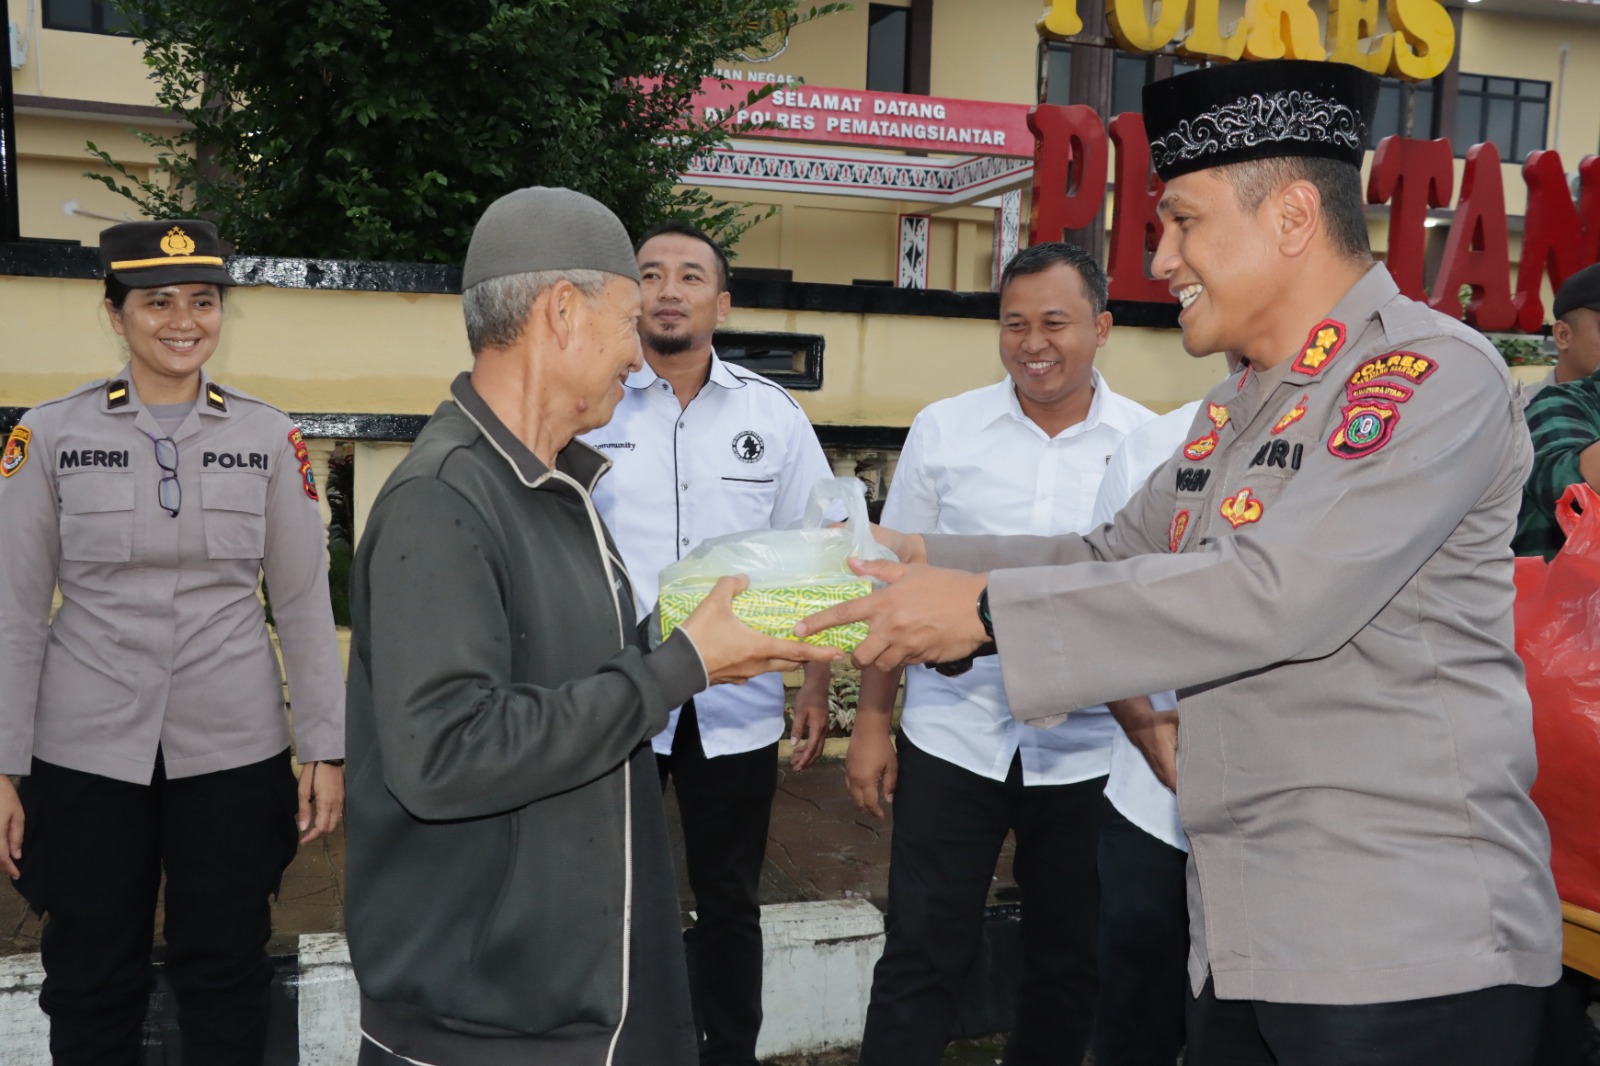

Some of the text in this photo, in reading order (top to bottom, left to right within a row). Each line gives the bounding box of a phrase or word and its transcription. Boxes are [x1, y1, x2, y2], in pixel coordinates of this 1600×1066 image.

[771, 90, 946, 120] SELAMAT DATANG
[736, 109, 816, 131] POLRES
[826, 116, 1006, 146] PEMATANGSIANTAR
[1351, 355, 1429, 384] POLRES
[59, 449, 129, 469] MERRI
[202, 452, 268, 470] POLRI
